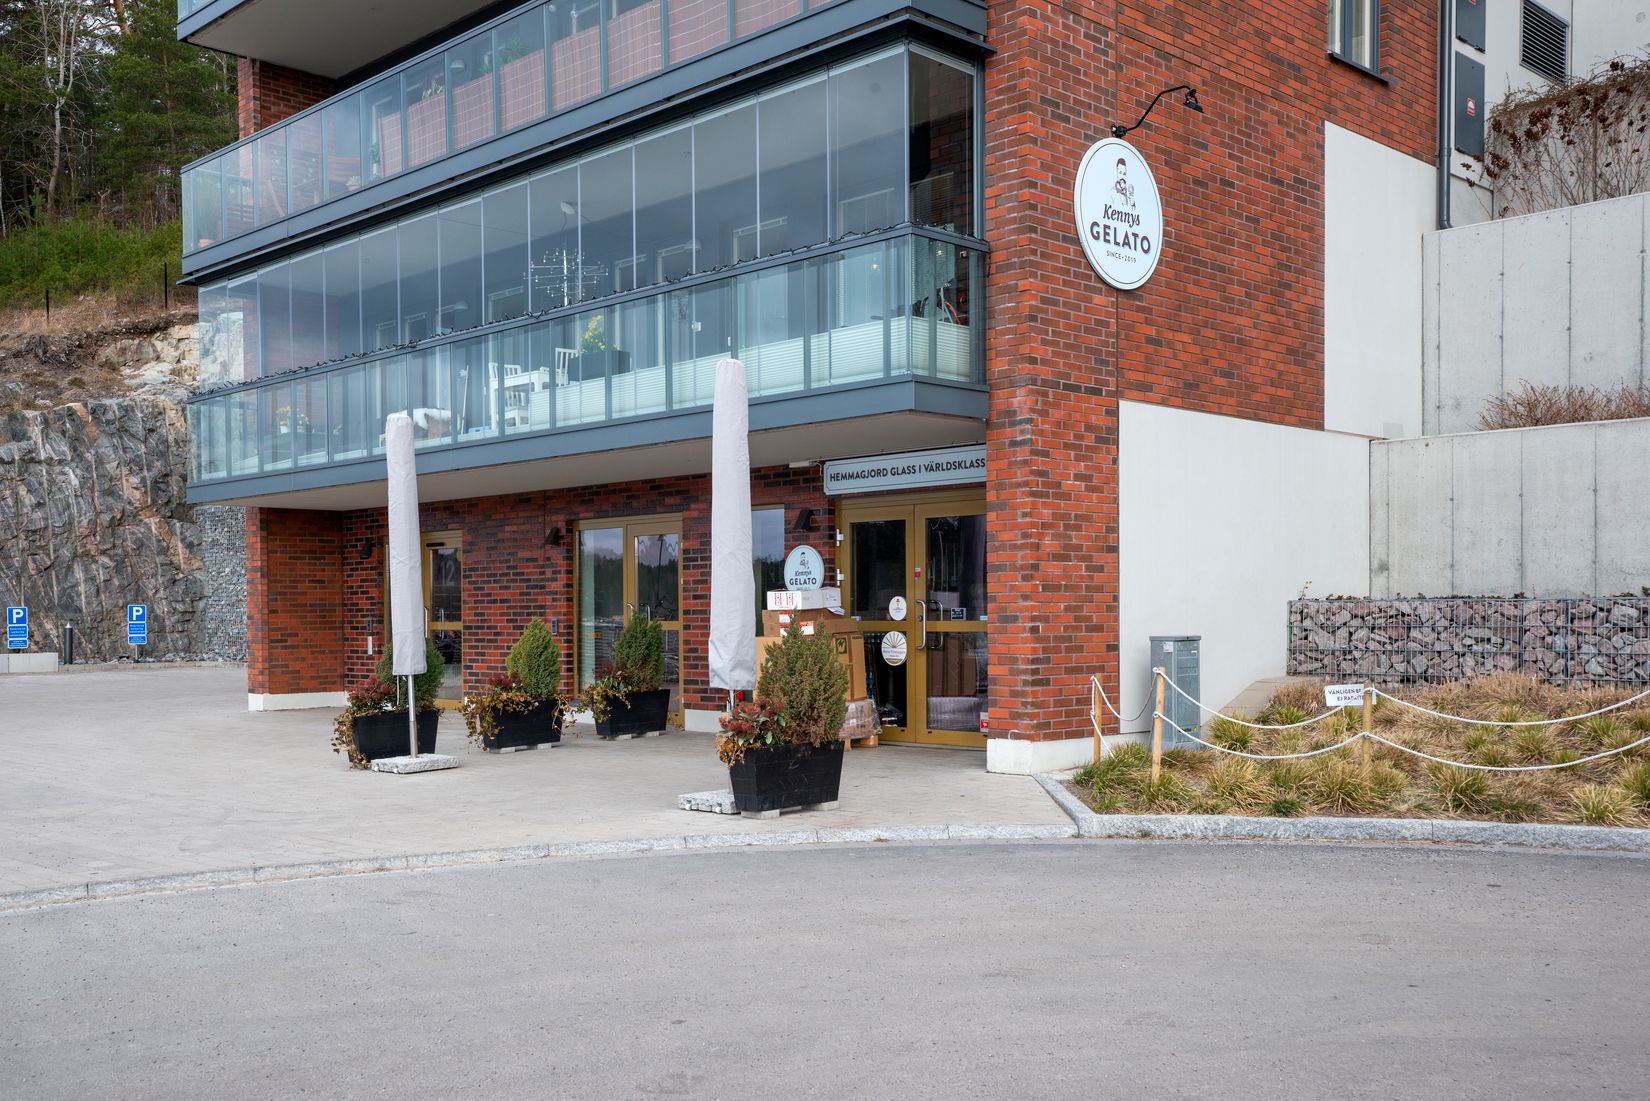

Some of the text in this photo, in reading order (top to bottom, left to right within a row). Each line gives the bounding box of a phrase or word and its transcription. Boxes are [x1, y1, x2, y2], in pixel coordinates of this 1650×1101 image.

[1103, 204, 1140, 228] Kennys
[1090, 221, 1151, 254] GELATO
[829, 458, 986, 482] HEMMAGJORD GLASS I VÄRLDSKLASS
[789, 577, 817, 586] GELATO
[12, 608, 24, 624] P
[132, 606, 143, 621] P
